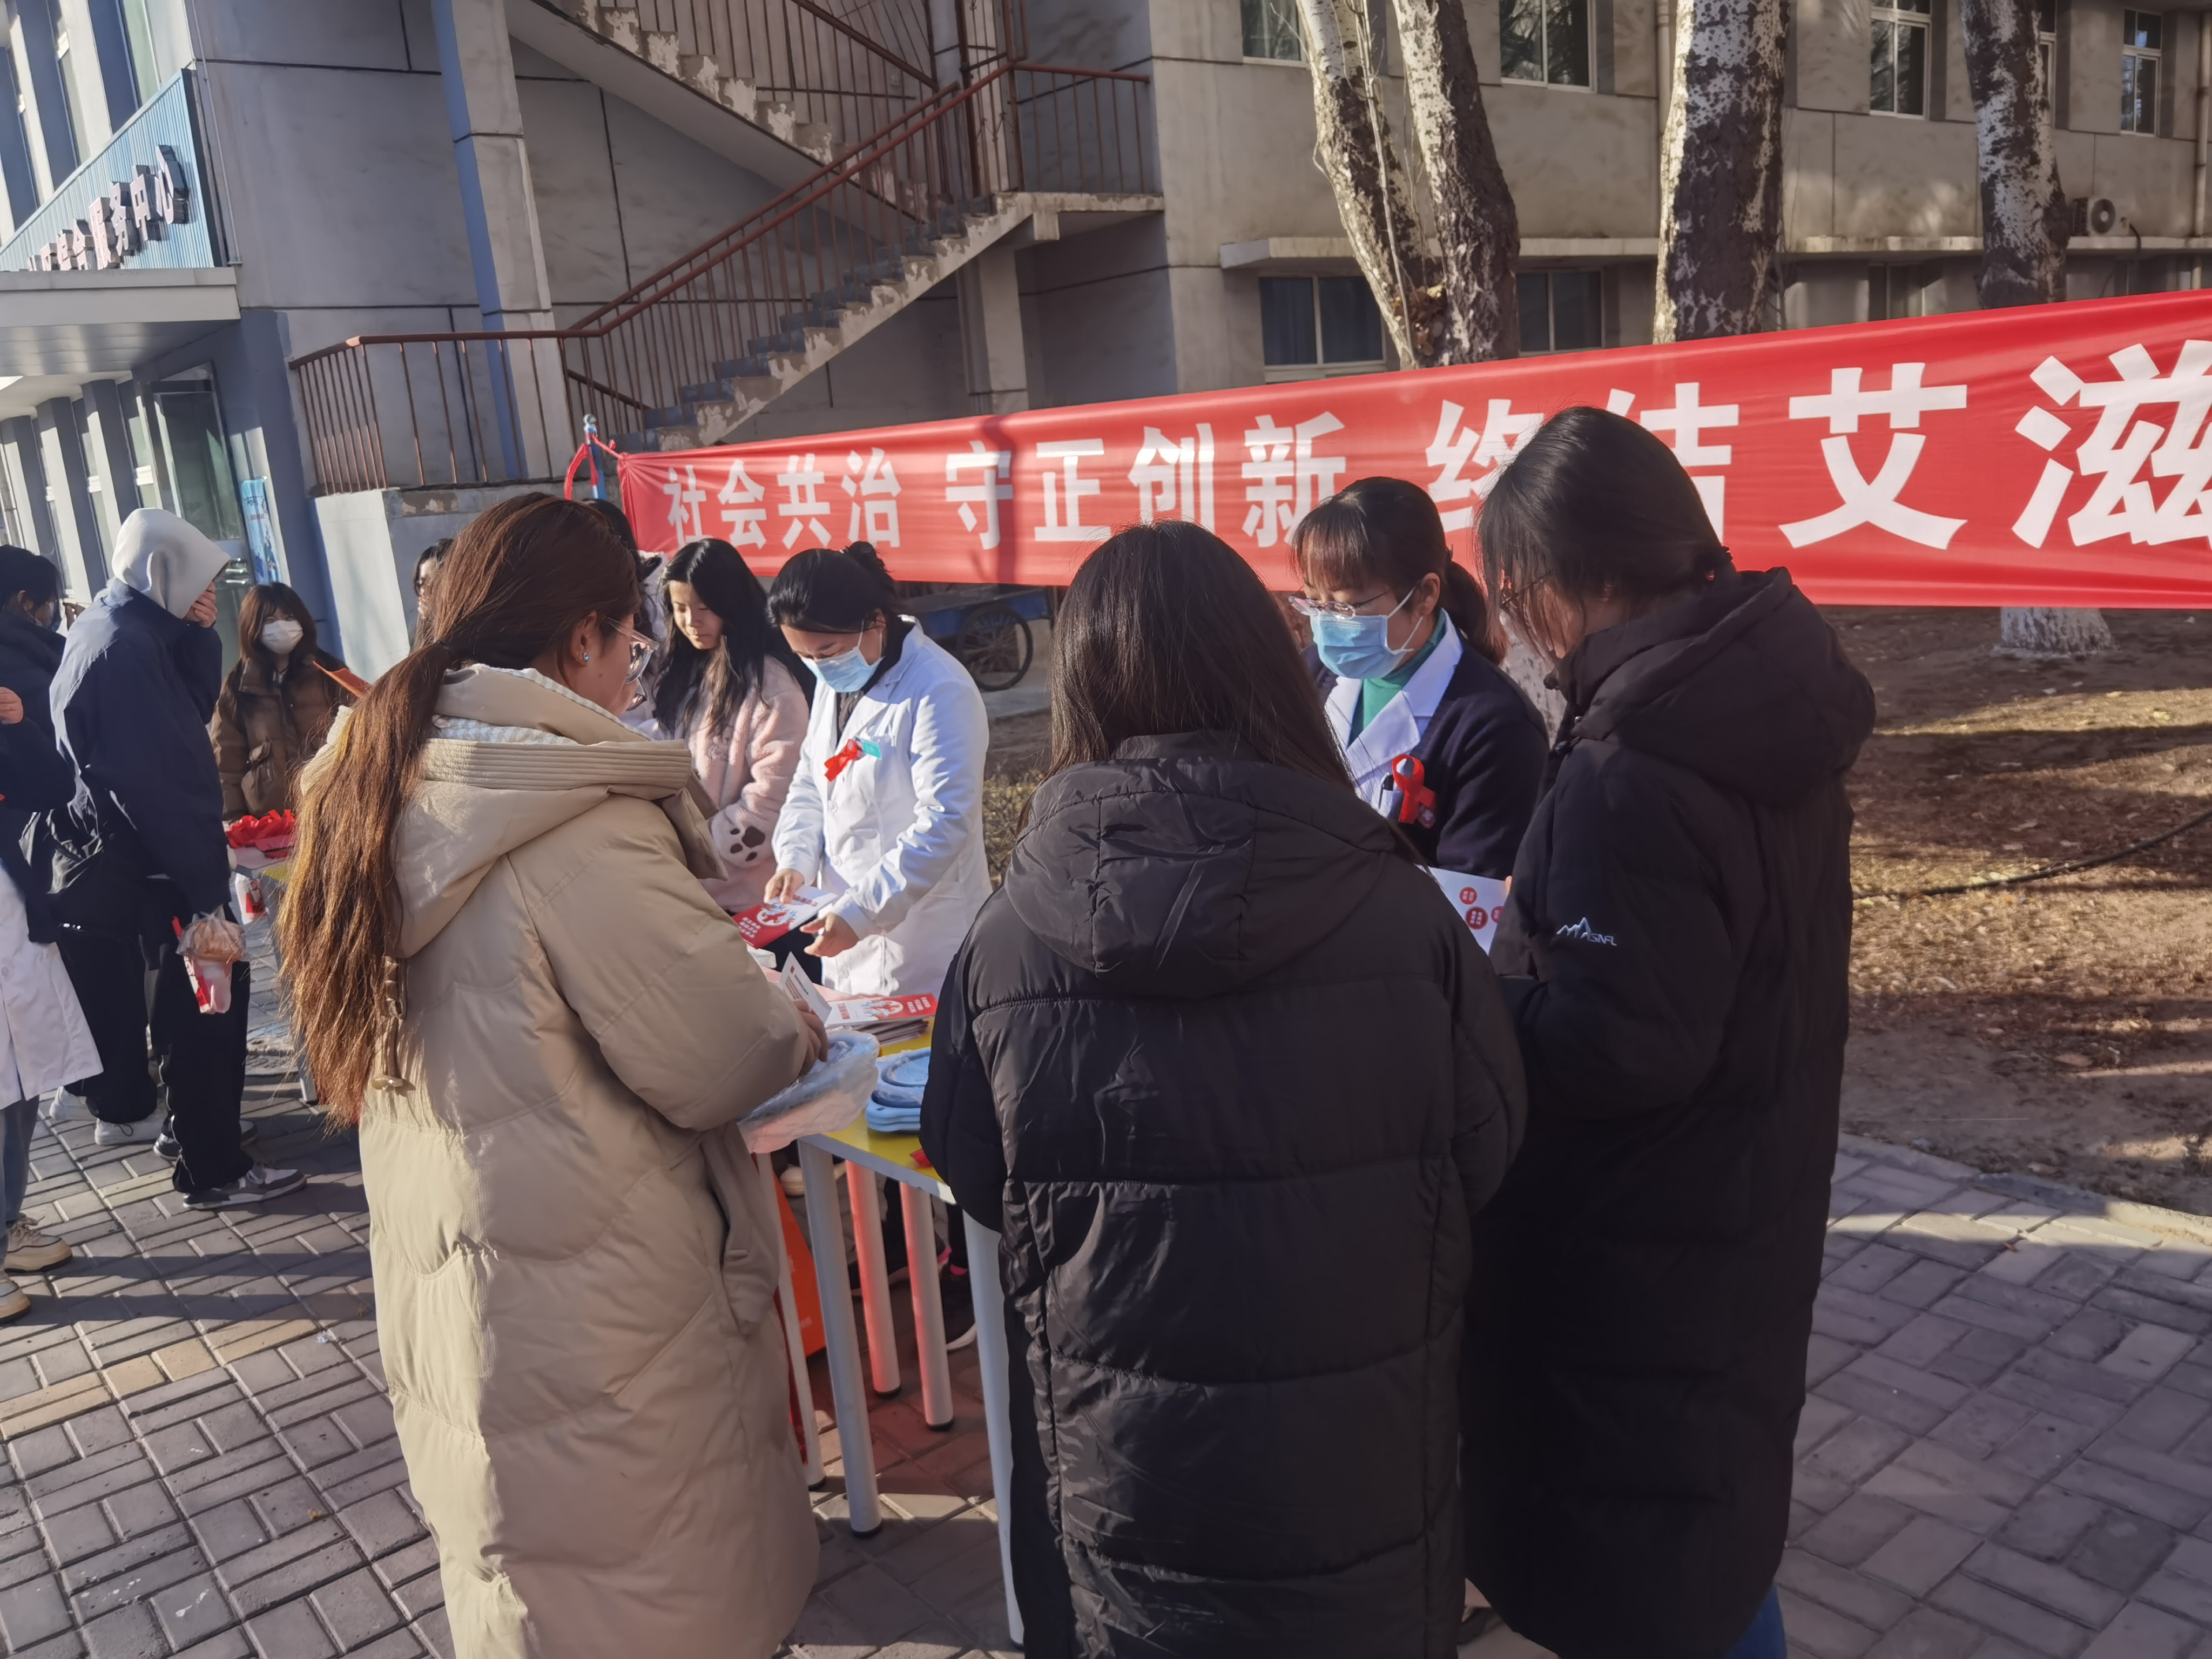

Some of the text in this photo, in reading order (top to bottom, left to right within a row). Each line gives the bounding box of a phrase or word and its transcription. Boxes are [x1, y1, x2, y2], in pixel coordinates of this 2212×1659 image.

[664, 447, 901, 550] 社会共治
[945, 411, 1346, 550] 守正创新
